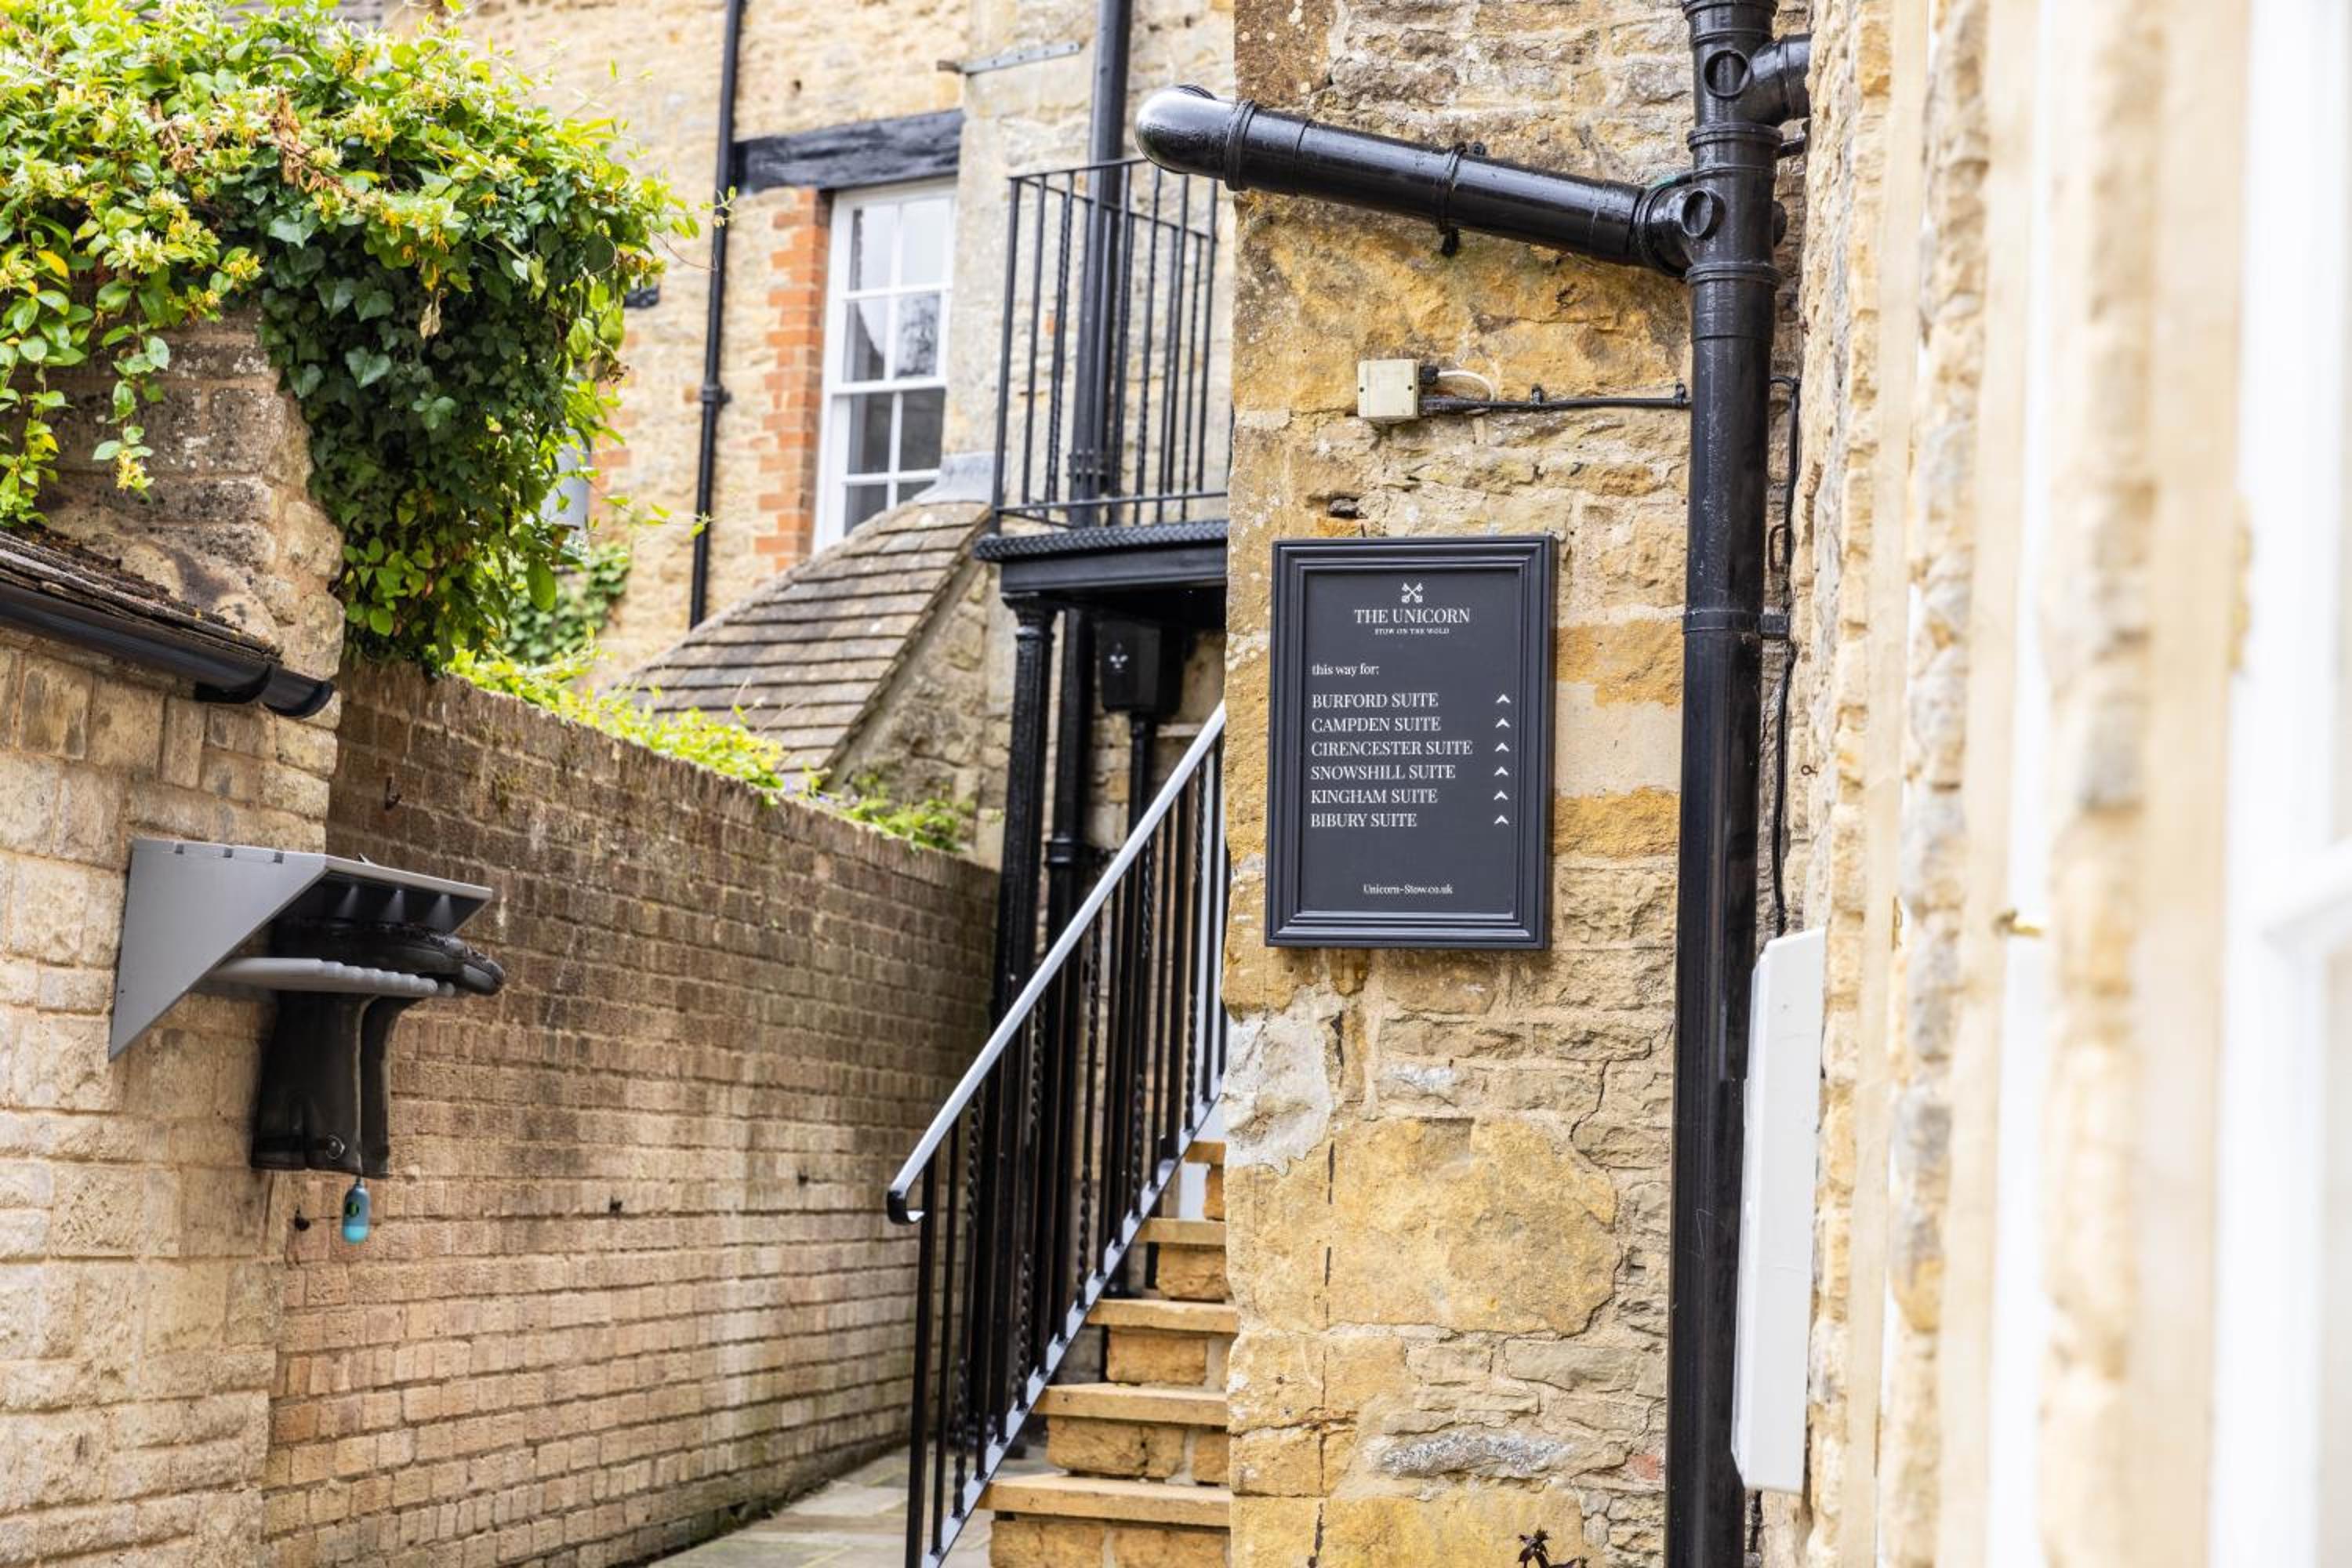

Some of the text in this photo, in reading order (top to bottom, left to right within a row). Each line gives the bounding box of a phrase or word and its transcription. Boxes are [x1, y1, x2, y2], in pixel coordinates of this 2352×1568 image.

[1354, 608, 1470, 623] THE UNICORN
[1312, 664, 1333, 675] this
[1335, 666, 1357, 677] way
[1312, 692, 1439, 709] BURFORD SUITE
[1312, 717, 1441, 732] CAMPDEN SUITE
[1311, 740, 1472, 756] CIRENCESTER SUITE
[1311, 765, 1455, 780] SNOWSHILL SUITE
[1312, 789, 1438, 804] KINGHAM SUITE
[1311, 813, 1417, 827] BIBURY SUITE
